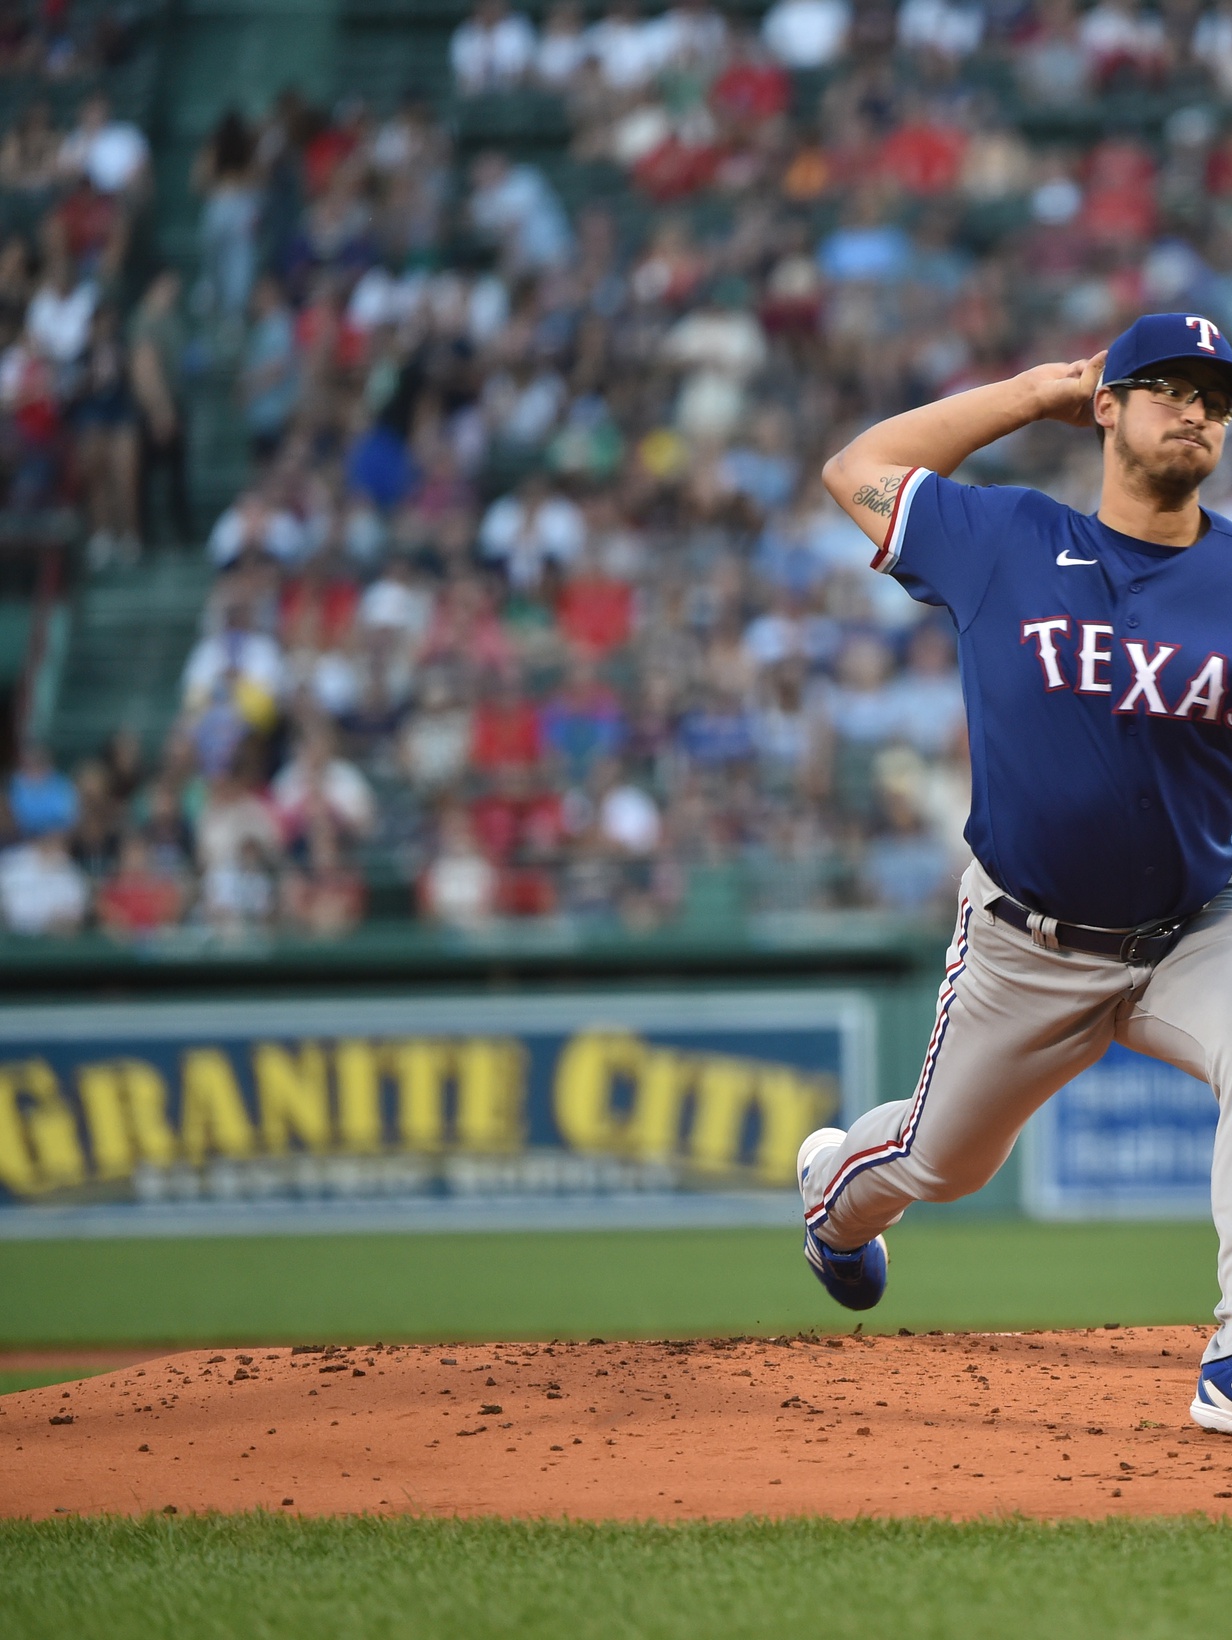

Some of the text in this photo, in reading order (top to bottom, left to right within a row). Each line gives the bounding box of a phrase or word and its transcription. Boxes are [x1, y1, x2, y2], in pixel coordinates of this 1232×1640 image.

[1185, 316, 1221, 354] T
[0, 1024, 838, 1196] GRANITE CITY
